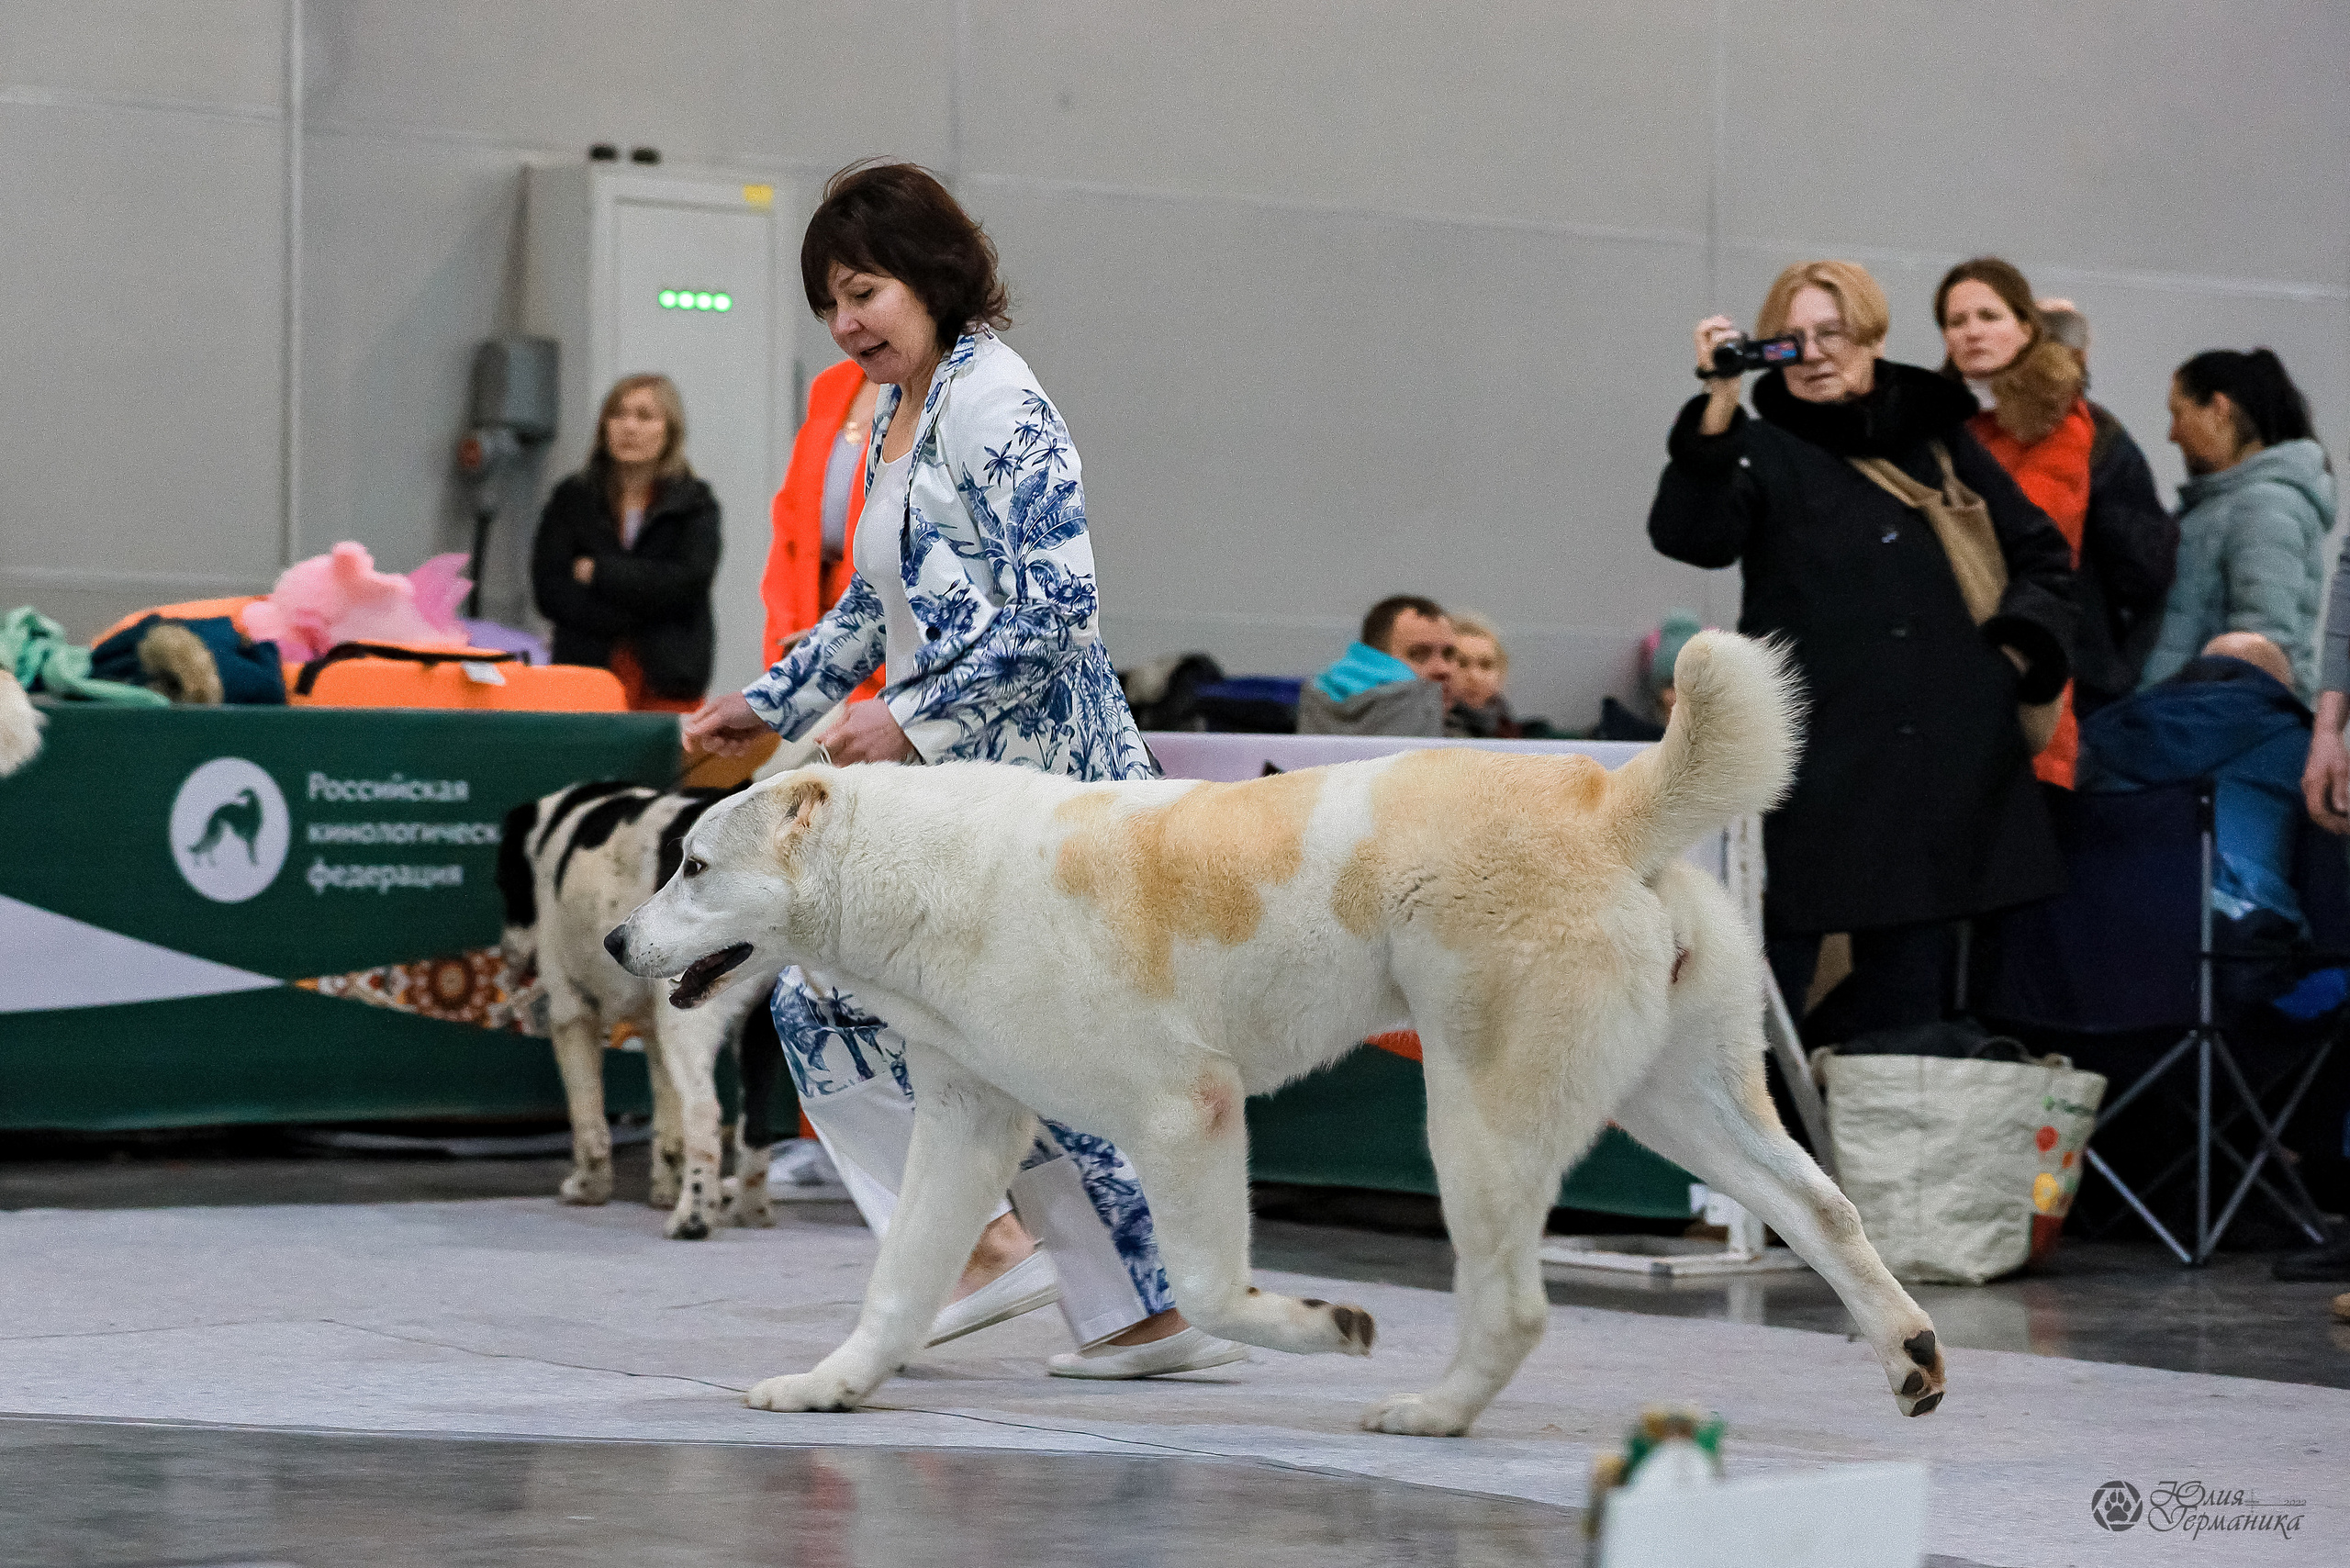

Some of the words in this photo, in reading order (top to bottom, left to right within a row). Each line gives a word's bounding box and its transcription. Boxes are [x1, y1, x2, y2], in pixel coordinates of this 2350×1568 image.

[308, 772, 469, 801] Российская
[308, 823, 502, 845] кинологическ
[307, 857, 463, 894] федерация
